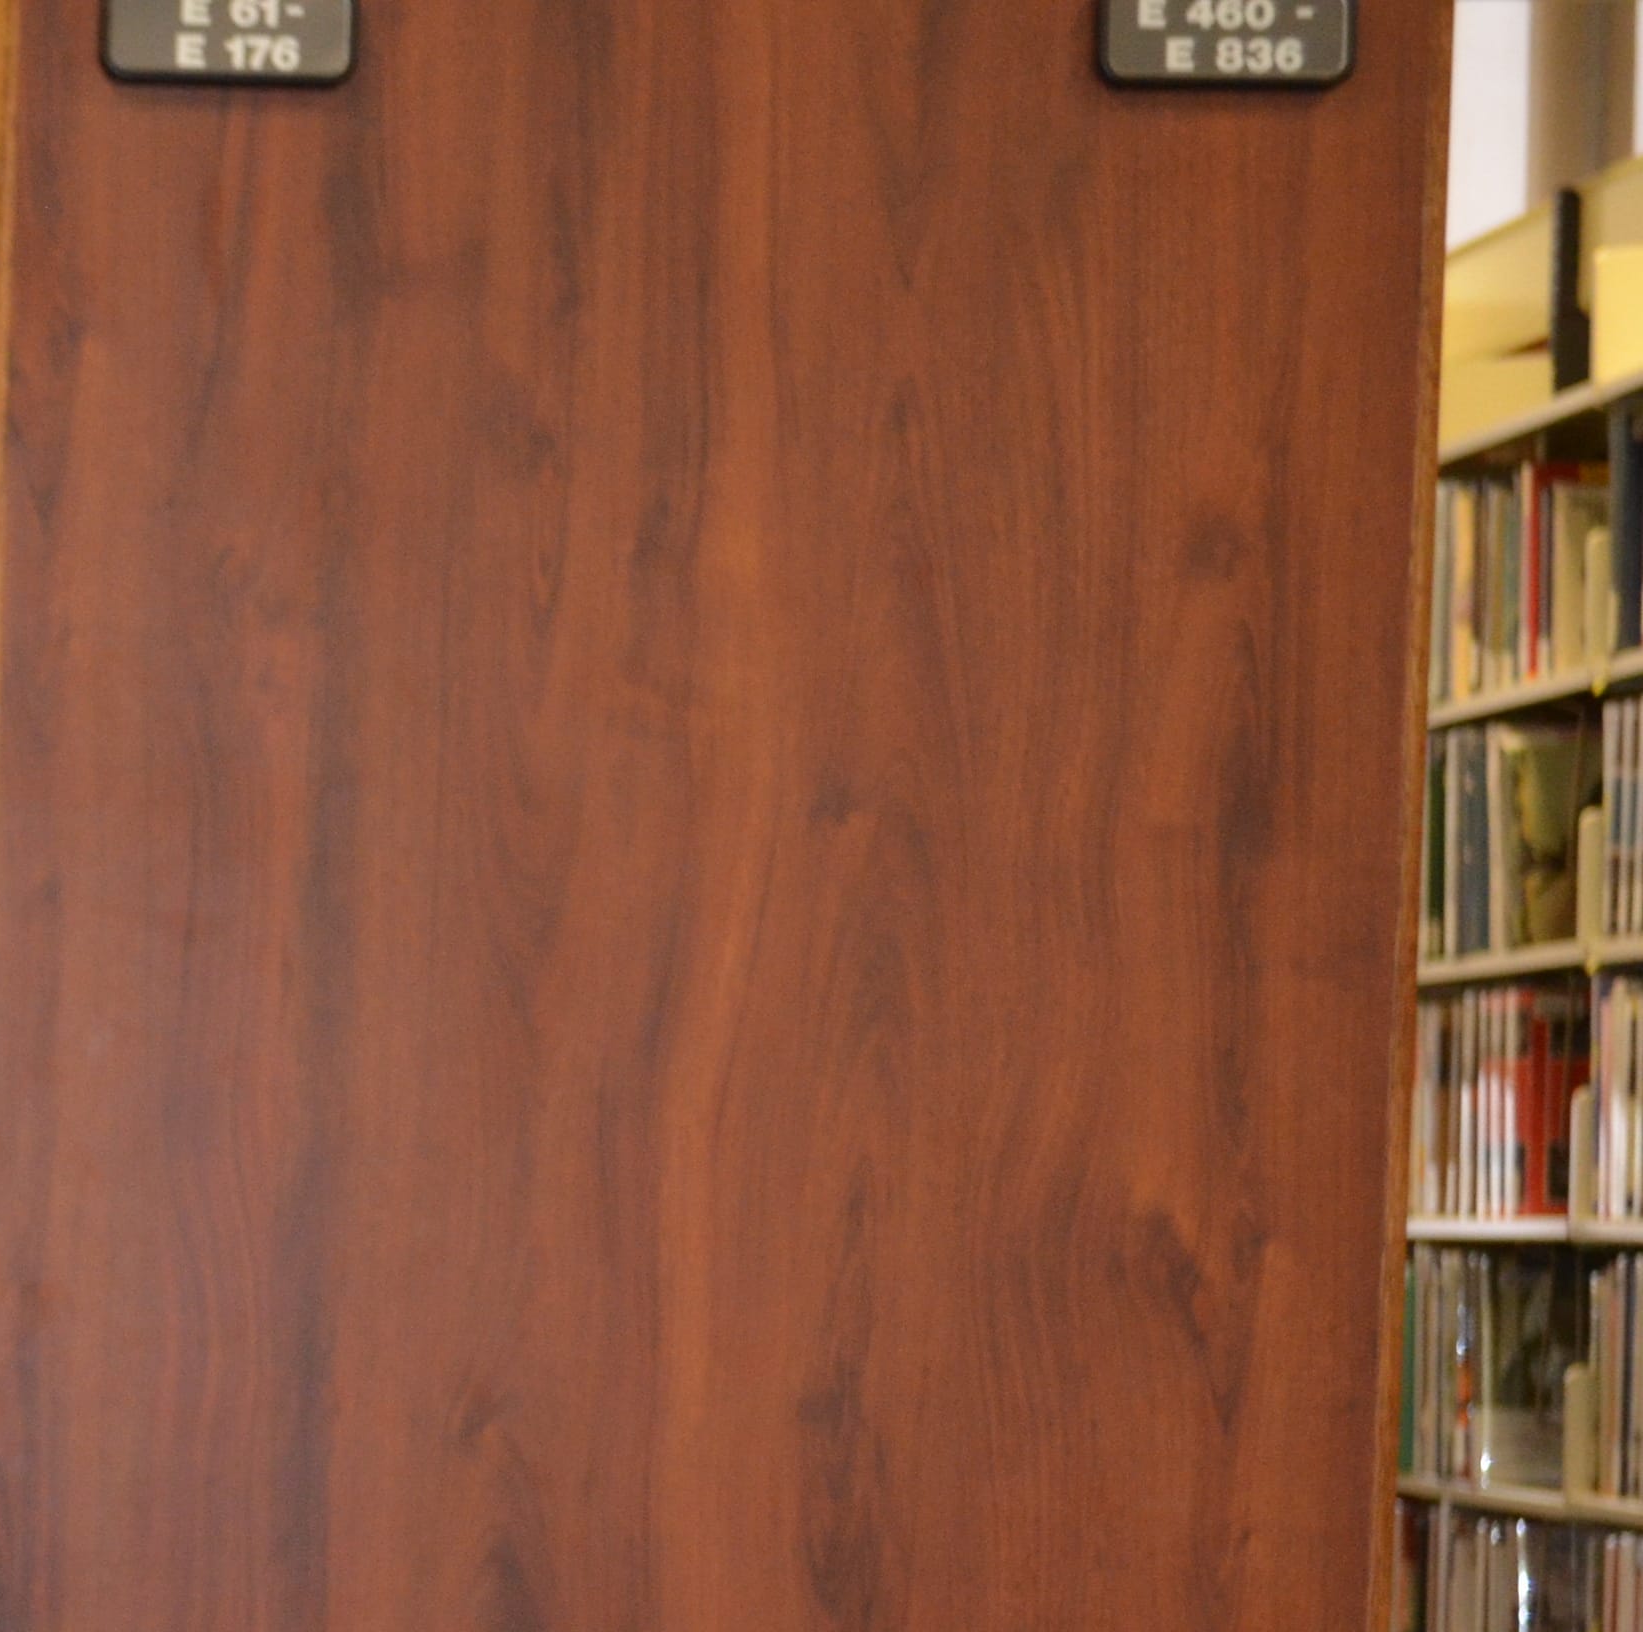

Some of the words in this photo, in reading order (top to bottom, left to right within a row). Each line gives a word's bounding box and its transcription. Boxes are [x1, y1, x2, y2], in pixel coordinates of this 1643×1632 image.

[179, 0, 212, 27] E
[1136, 0, 1167, 30] E
[1185, 0, 1276, 31] 460
[174, 32, 207, 70] E
[223, 34, 301, 72] 176
[1165, 36, 1196, 73] E
[1216, 36, 1304, 74] 836
